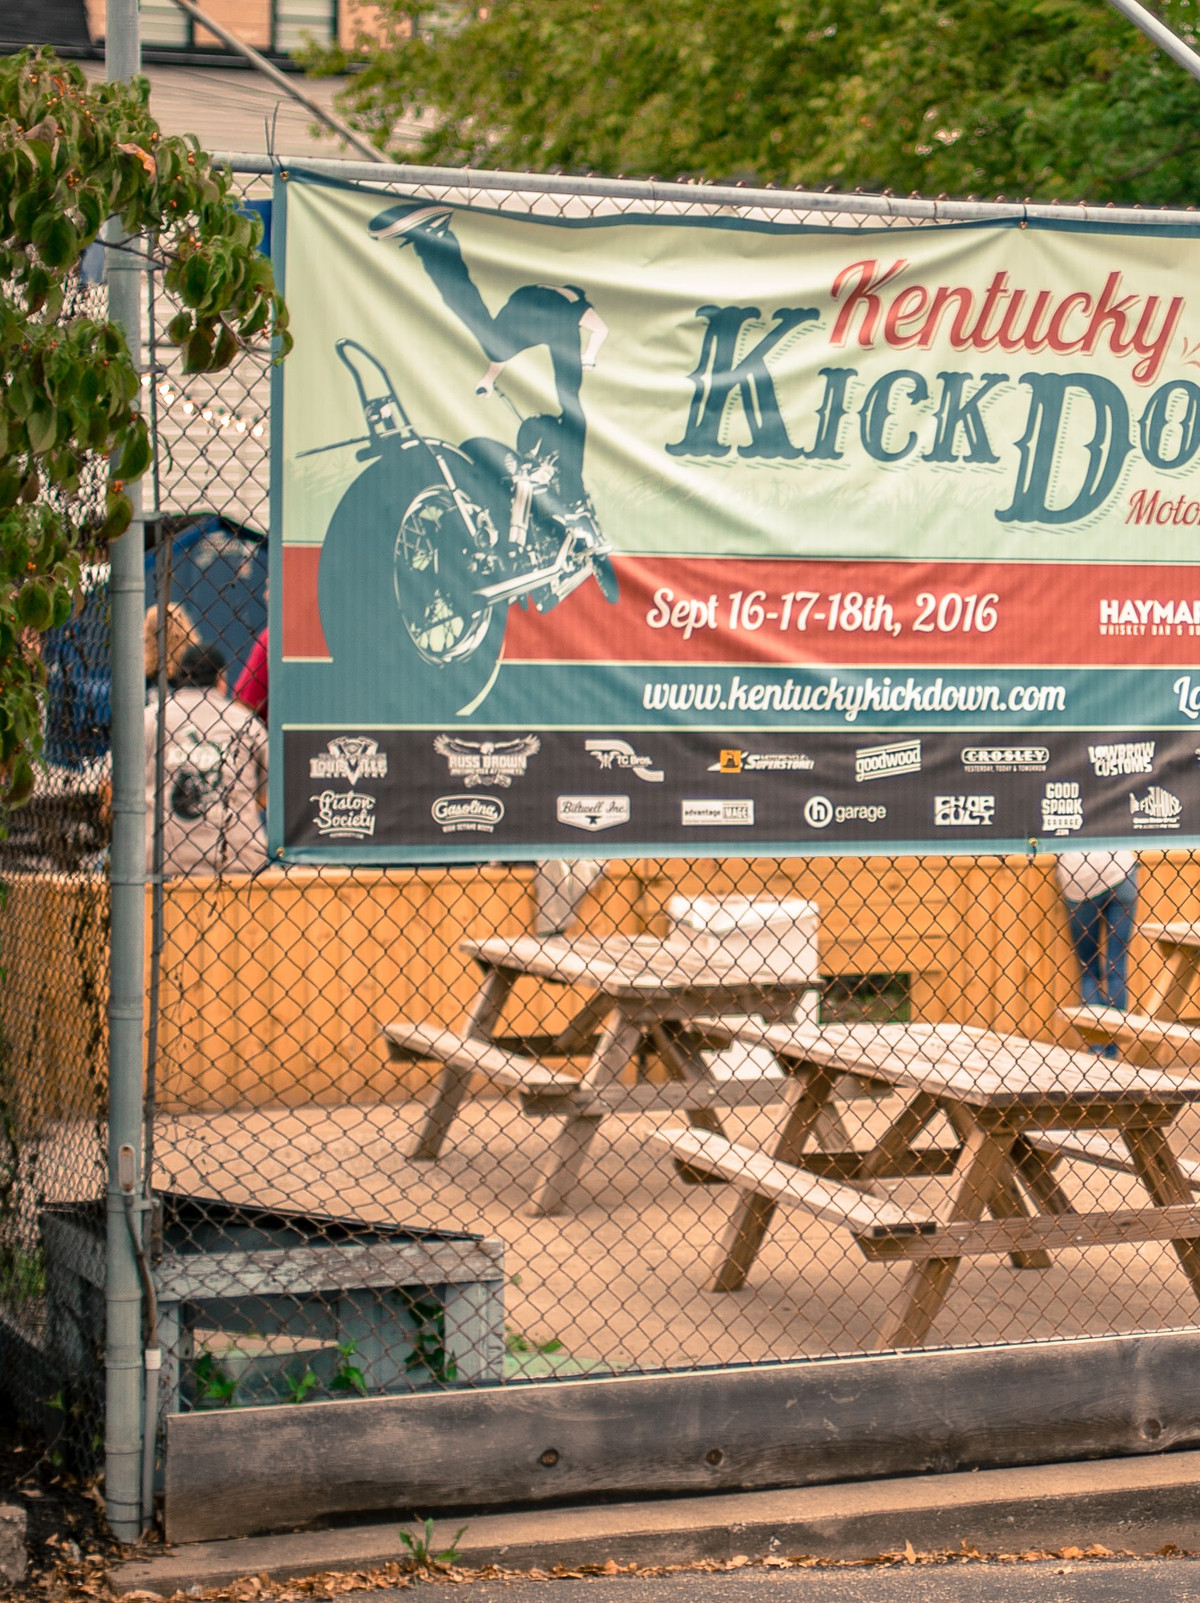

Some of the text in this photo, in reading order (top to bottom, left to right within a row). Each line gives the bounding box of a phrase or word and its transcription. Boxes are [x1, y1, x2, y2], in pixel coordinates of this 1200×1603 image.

[830, 258, 1184, 386] Kentucky
[645, 587, 1000, 640] Sept 16-17-18th, 2016
[1099, 625, 1146, 636] WHISKEY
[1152, 625, 1171, 636] BAR
[642, 676, 1067, 721] www.kentuckykickdown.com
[616, 755, 629, 765] TC
[967, 750, 1046, 761] CROSLEY
[1087, 741, 1156, 763] LOWBROW
[448, 755, 527, 769] RUSS BROWN
[855, 743, 921, 782] goodwood
[1094, 758, 1153, 776] CUSTOMS
[1045, 782, 1080, 798] GOOD
[310, 790, 376, 811] Piston
[562, 800, 604, 814] Biltwell
[1041, 798, 1083, 814] SPARK
[312, 809, 375, 836] Society
[684, 809, 721, 818] advantage
[835, 805, 887, 823] garage
